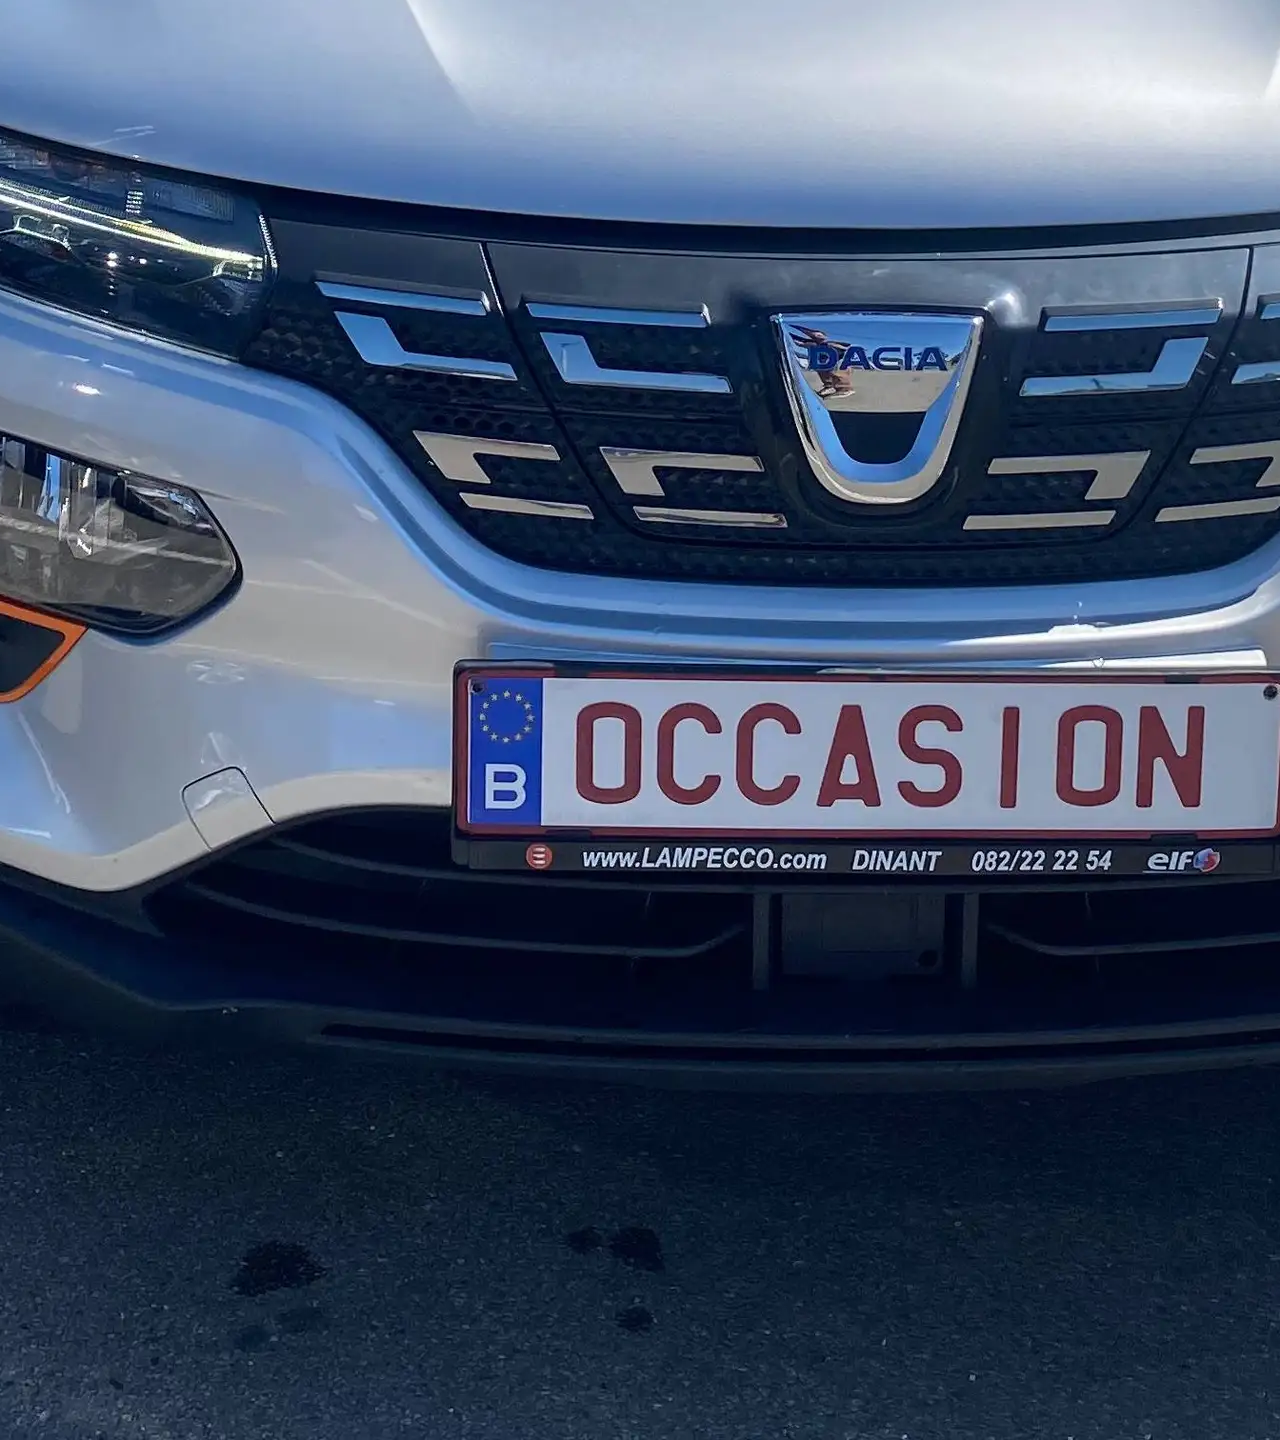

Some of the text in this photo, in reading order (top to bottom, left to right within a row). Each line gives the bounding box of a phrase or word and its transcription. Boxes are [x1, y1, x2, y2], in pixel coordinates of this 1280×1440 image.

[808, 346, 948, 372] DACIA
[575, 701, 1205, 808] OCCASION
[484, 763, 527, 810] B
[582, 845, 1195, 872] www.LAMPECCO.com DINANT 082/22 22 54 elf
